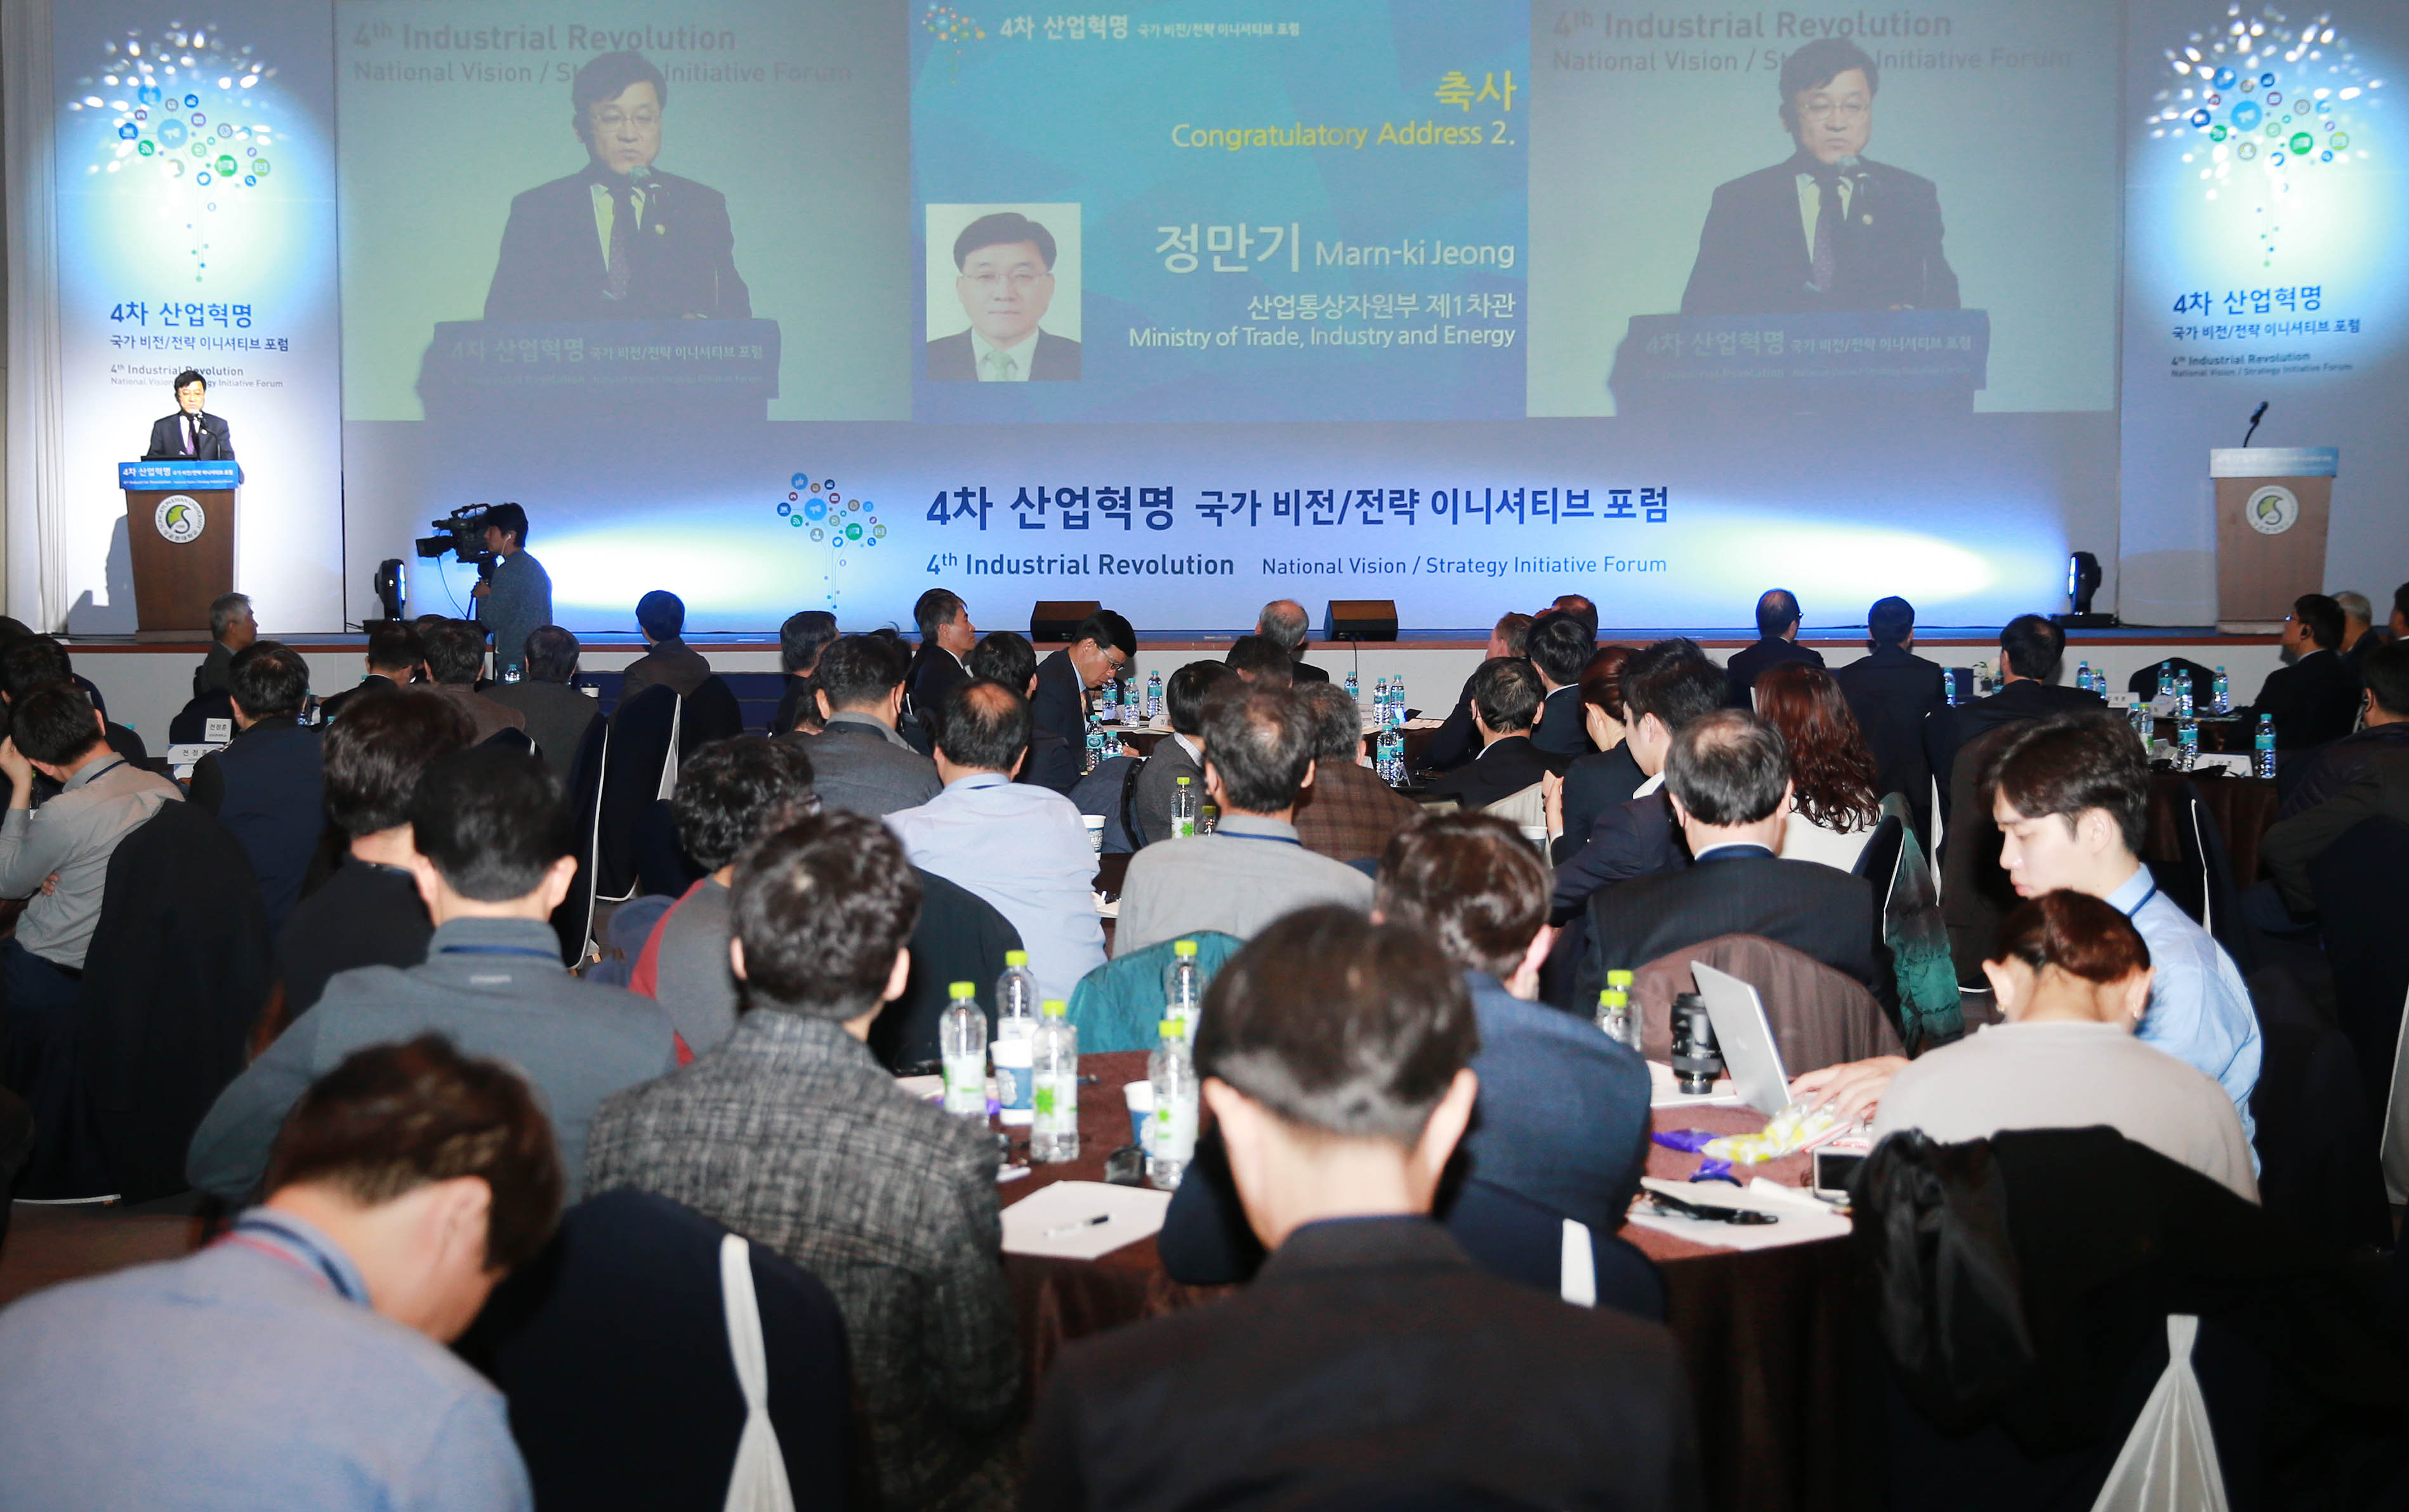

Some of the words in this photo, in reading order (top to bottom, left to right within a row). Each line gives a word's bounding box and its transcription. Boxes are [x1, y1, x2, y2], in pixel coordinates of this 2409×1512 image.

[403, 23, 557, 50] Industrial
[568, 23, 735, 50] Revolution
[1000, 16, 1034, 41] 4차
[1043, 15, 1128, 40] 산업혁명
[1605, 11, 1764, 38] Industrial
[1777, 10, 1951, 38] Revolution
[353, 61, 452, 82] National
[461, 62, 531, 82] Vision
[539, 60, 549, 84] /
[665, 62, 765, 82] Initiative
[774, 62, 851, 82] Forum
[1553, 49, 1656, 71] National
[1665, 50, 1738, 71] Vision
[1745, 48, 1756, 72] /
[1877, 48, 1982, 70] Initiative
[1991, 46, 2073, 69] Forum
[1434, 70, 1517, 112] 축사
[1171, 121, 1368, 152] Congratulatory
[1376, 120, 1483, 146] Address
[1490, 121, 1516, 146] 2.
[1155, 222, 1299, 273] 정만기
[1315, 239, 1425, 266] Marn-ki
[1432, 241, 1515, 269] Jeong
[1247, 293, 1420, 320] 산업통상자원부
[1425, 292, 1516, 319] 제1차관
[2173, 291, 2212, 316] 4차
[2224, 286, 2321, 315] 산업혁명
[110, 301, 149, 327] 4차
[159, 302, 252, 329] 산업혁명
[1129, 326, 1210, 350] Ministry
[1216, 325, 1239, 346] of
[1242, 326, 1305, 349] Trade,
[1311, 325, 1396, 348] Industry
[1398, 325, 1438, 345] and
[1444, 325, 1516, 348] Energy
[2172, 325, 2198, 340] 국가
[2202, 324, 2260, 339] 비전/전략
[2333, 319, 2360, 334] 포럼
[110, 335, 136, 349] 국가
[140, 336, 195, 350] 비전/전략
[200, 337, 261, 351] 이니셔티브
[264, 338, 289, 352] 포럼
[495, 338, 583, 363] 산업혁명
[1691, 331, 1785, 356] 산업혁명
[110, 364, 125, 374] 4th
[128, 365, 181, 375] Industrial
[2189, 355, 2244, 365] Industrial
[256, 379, 284, 388] Forum
[926, 486, 994, 530] 4차
[1009, 485, 1175, 530] 산업혁명
[1196, 489, 1262, 527] 국가
[1273, 489, 1420, 526] 비전/전략
[1431, 487, 1595, 525] 이니셔티브
[1603, 486, 1668, 523] 포럼
[927, 553, 958, 575] 4th
[966, 554, 1089, 575] Industrial
[1098, 554, 1234, 575] Revolution
[1262, 557, 1343, 574] National
[1349, 557, 1406, 574] Vision
[1412, 556, 1422, 575] /
[1426, 556, 1507, 577] Strategy
[1514, 556, 1597, 573] Initiative
[1603, 556, 1667, 572] Forum
